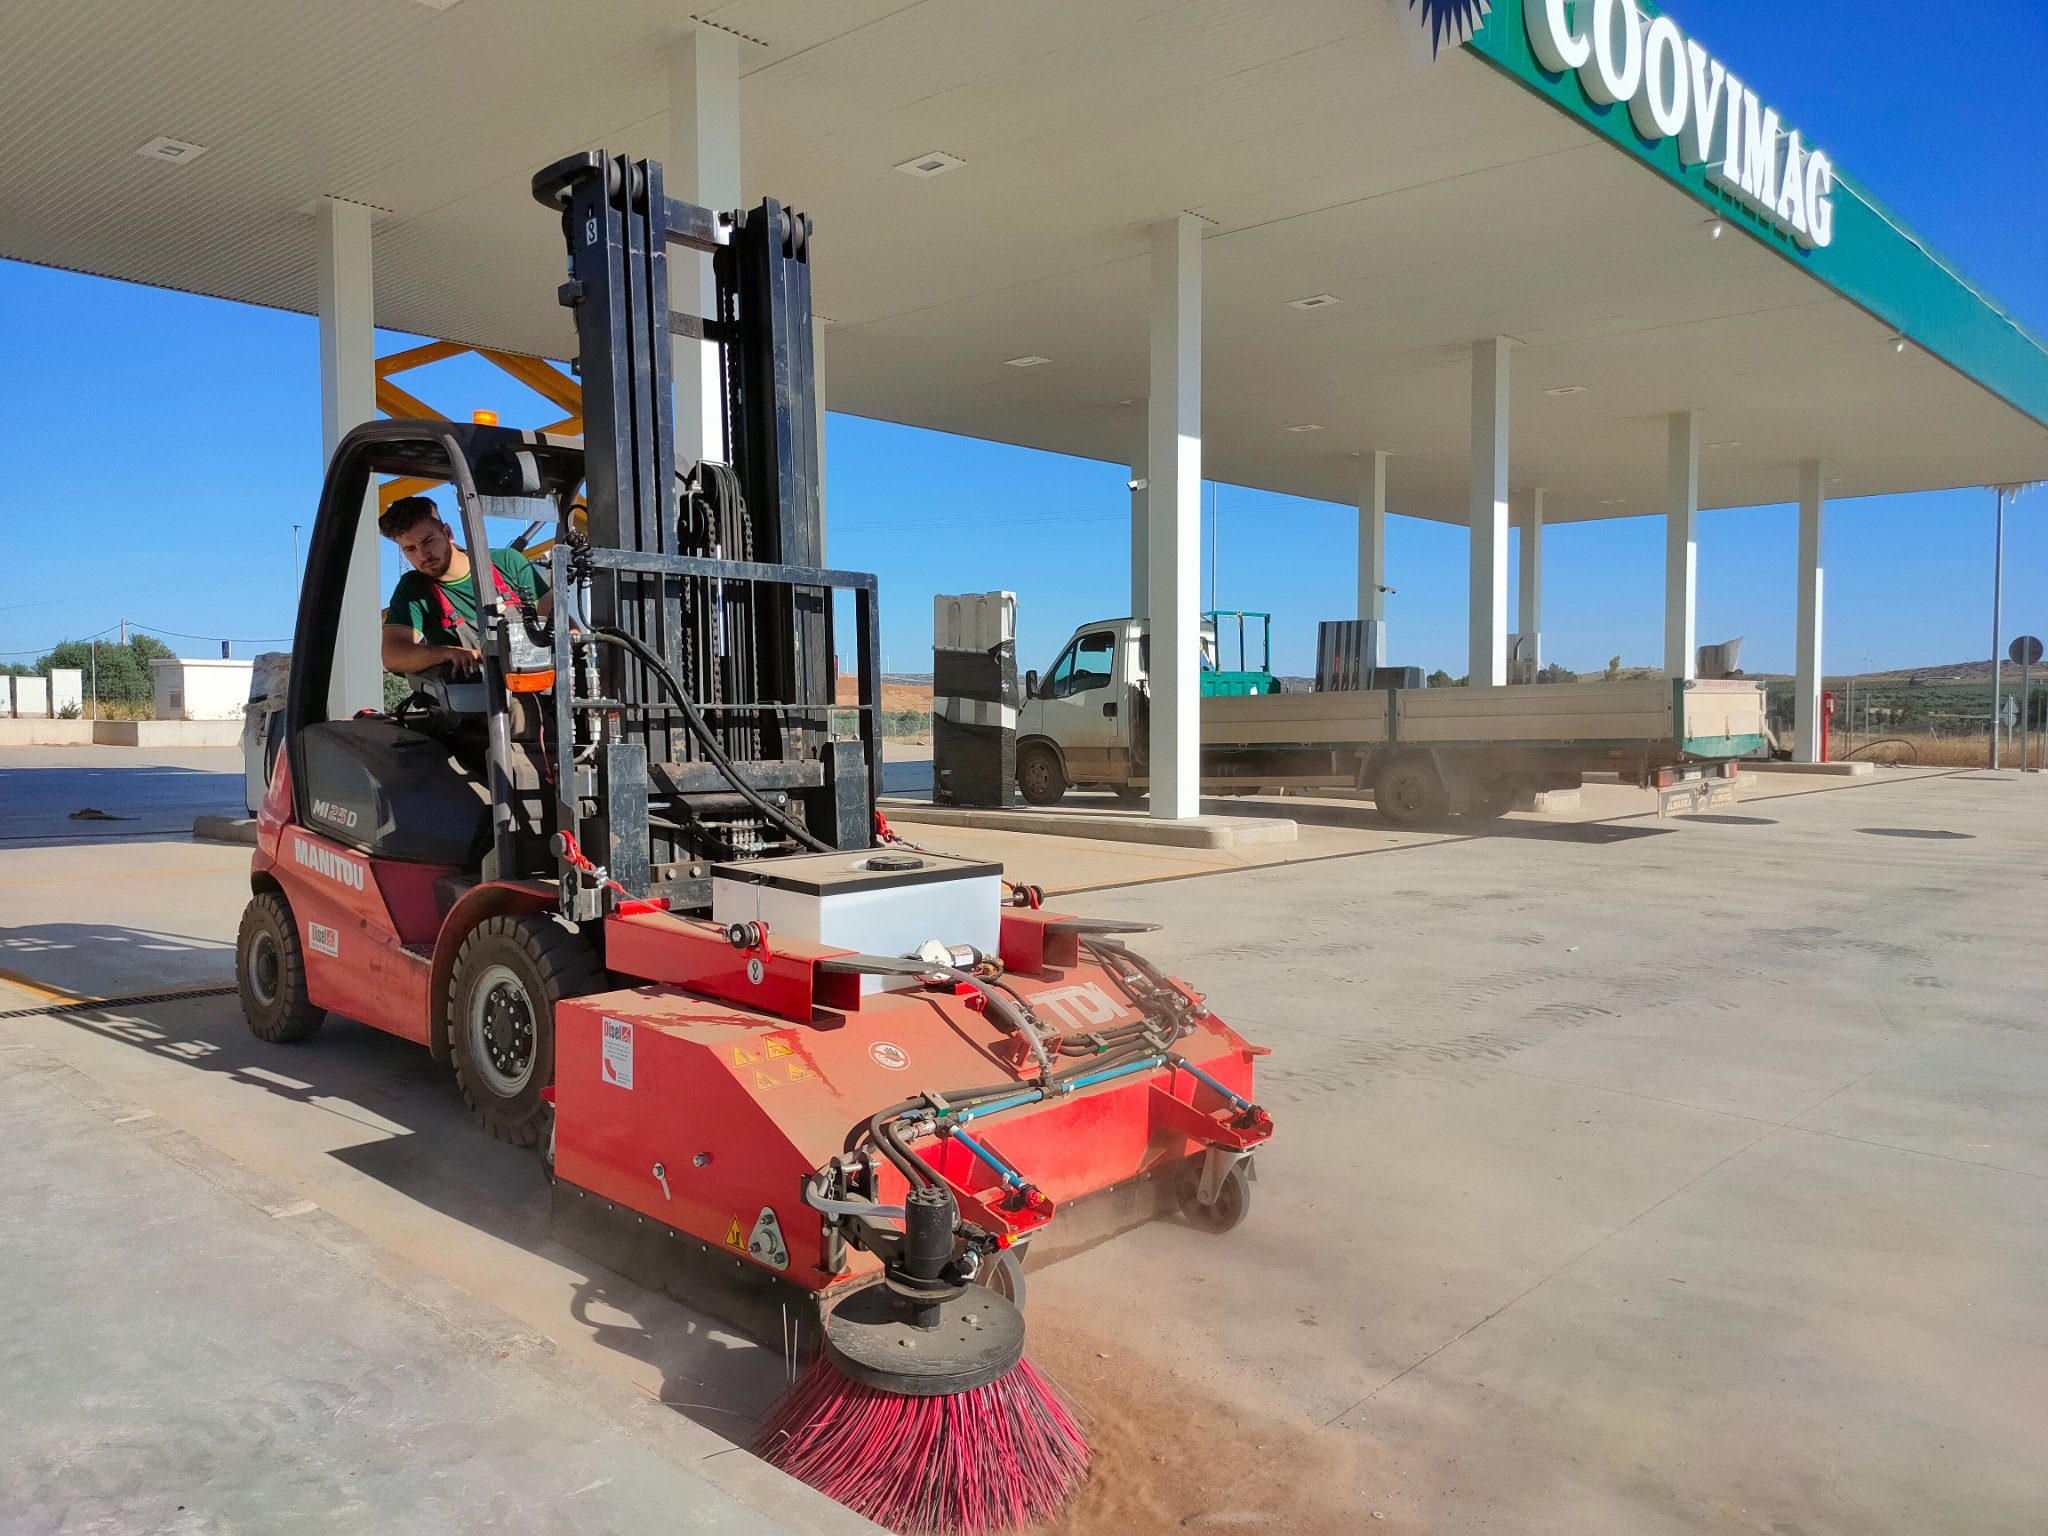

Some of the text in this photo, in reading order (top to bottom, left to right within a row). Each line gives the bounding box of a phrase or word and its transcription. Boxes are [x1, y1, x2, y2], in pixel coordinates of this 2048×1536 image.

[294, 836, 364, 891] MANITOU
[1025, 982, 1130, 1029] TDI
[604, 1021, 622, 1041] Disel
